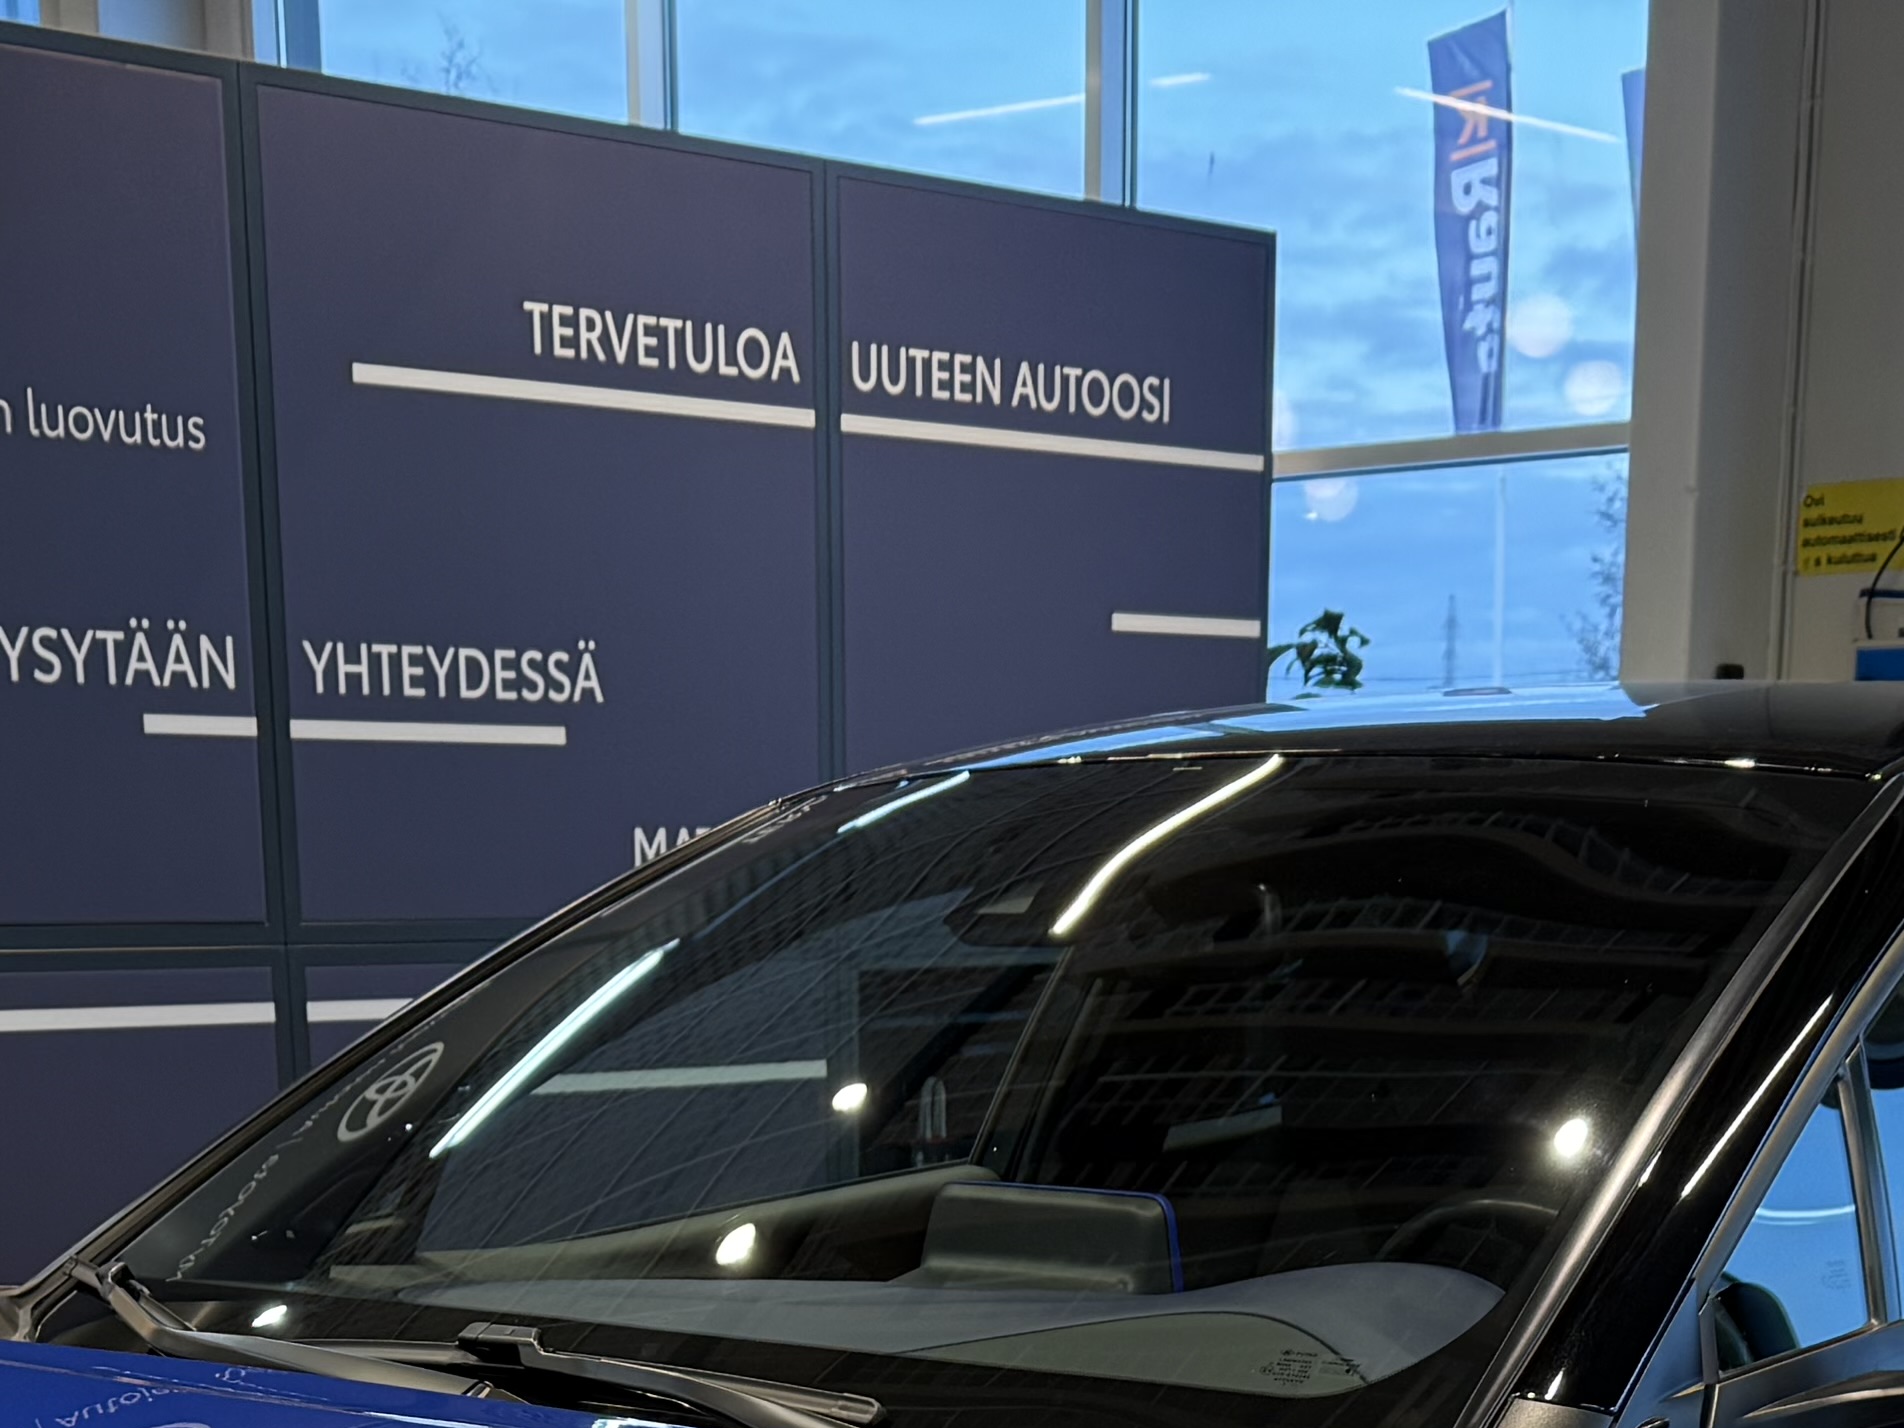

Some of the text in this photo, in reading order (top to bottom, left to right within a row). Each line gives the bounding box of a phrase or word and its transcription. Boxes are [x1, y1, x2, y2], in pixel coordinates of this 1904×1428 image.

[522, 299, 1171, 425] TERVETULOA UUTEEN AUTOOSI
[26, 386, 207, 451] luovutus
[303, 640, 604, 704] YHTEYDESSÄ
[632, 825, 714, 869] MA
